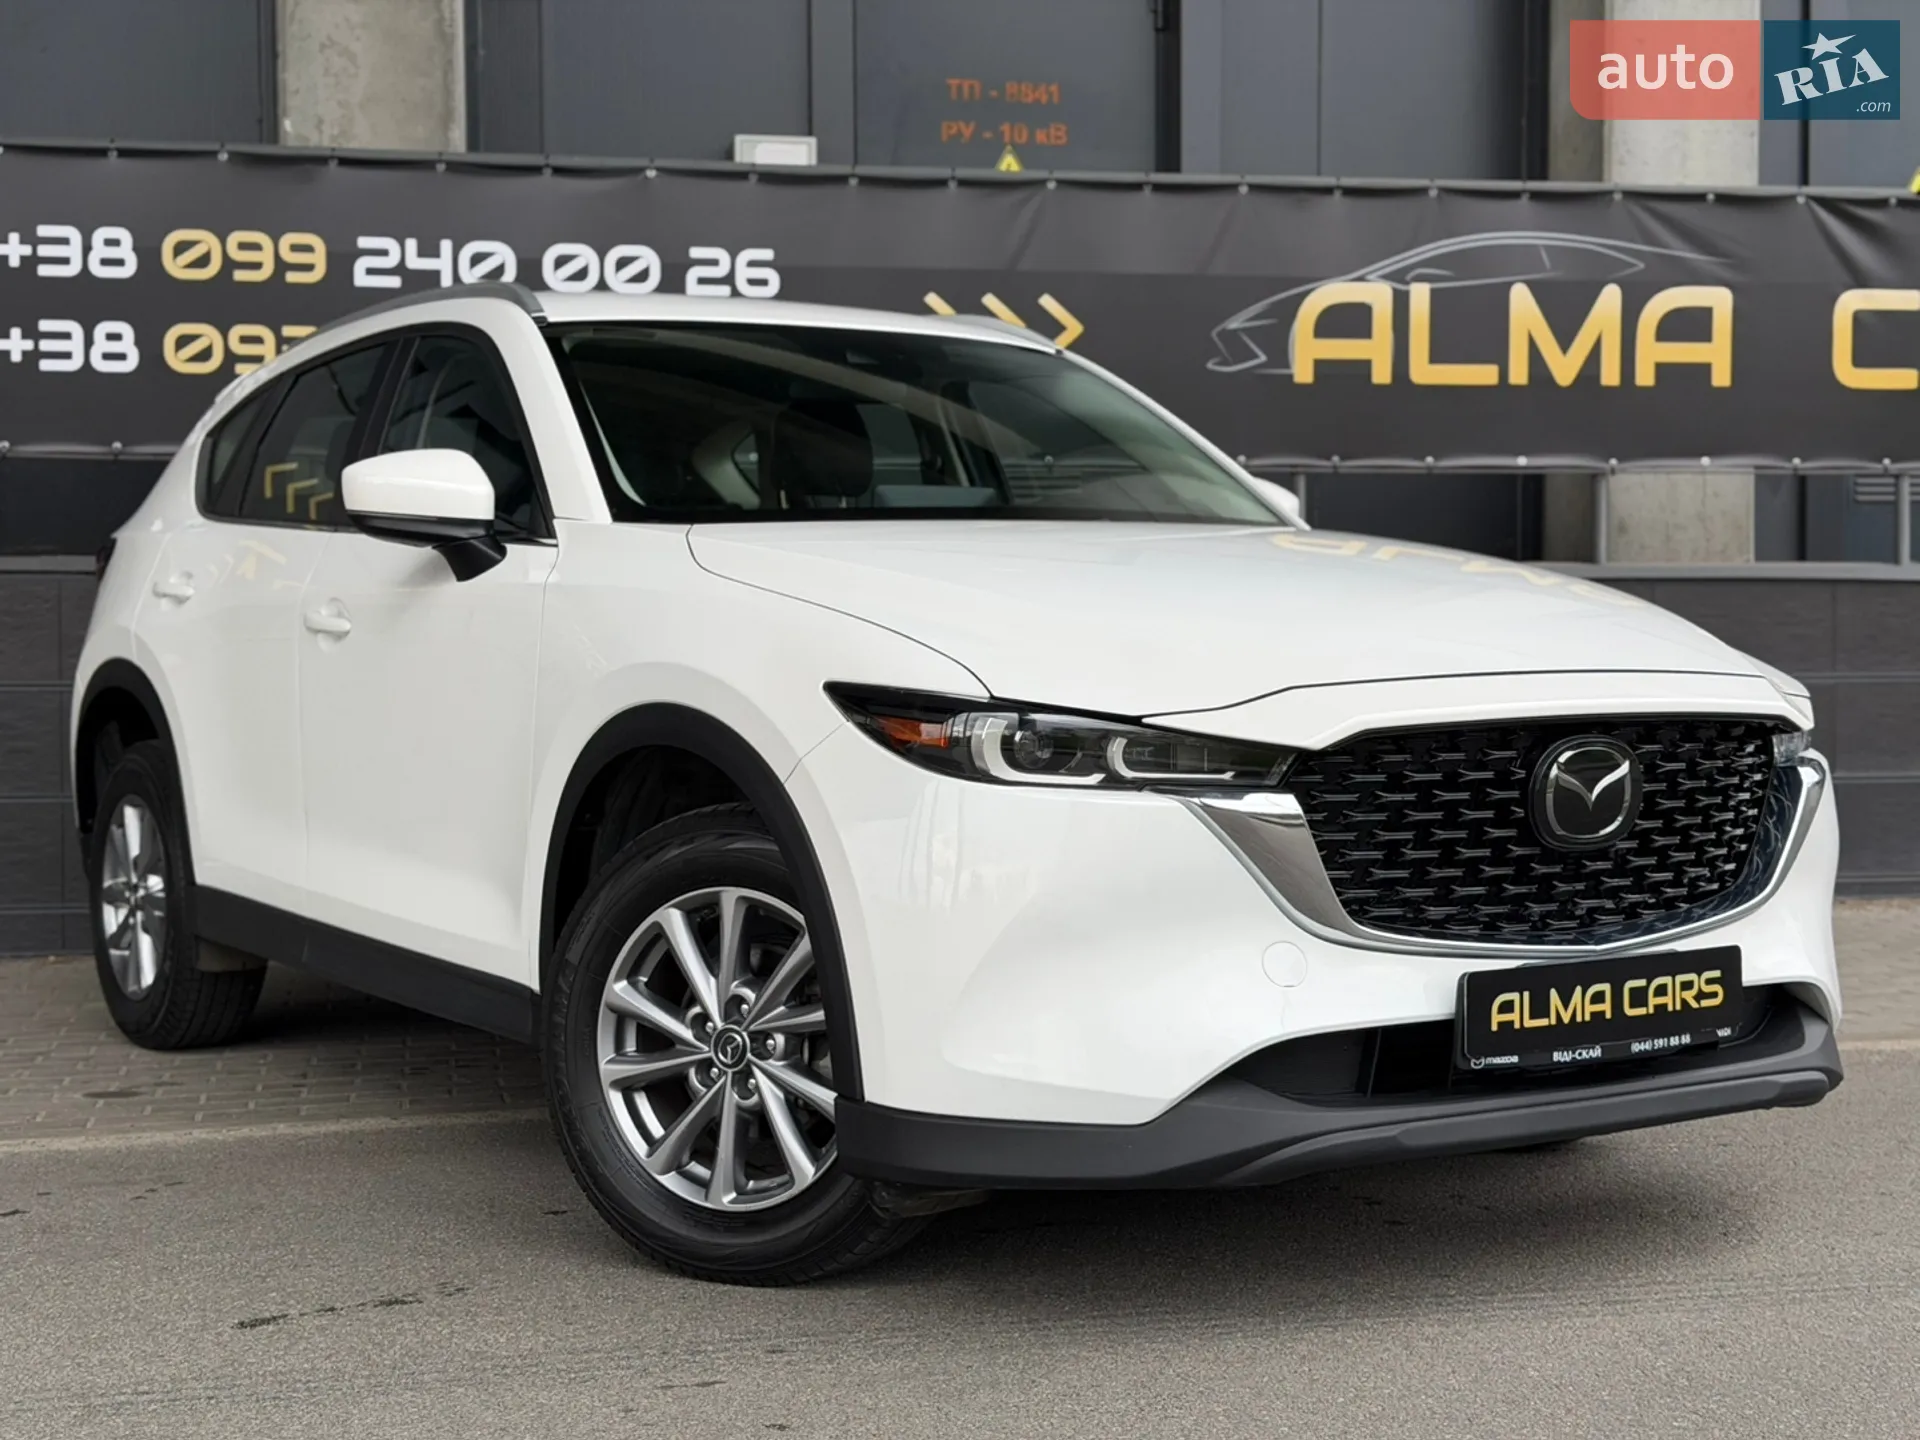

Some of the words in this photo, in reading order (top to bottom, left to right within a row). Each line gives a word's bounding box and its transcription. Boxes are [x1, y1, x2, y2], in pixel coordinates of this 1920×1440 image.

[1000, 122, 1028, 145] 10
[0, 225, 138, 279] +38
[161, 228, 327, 284] 099
[353, 236, 518, 288] 240
[542, 242, 662, 294] 00
[685, 246, 781, 298] 26
[0, 319, 140, 373] +38
[1292, 281, 1734, 387] ALMA
[1491, 982, 1612, 1032] ALMA
[1623, 970, 1724, 1017] CARS
